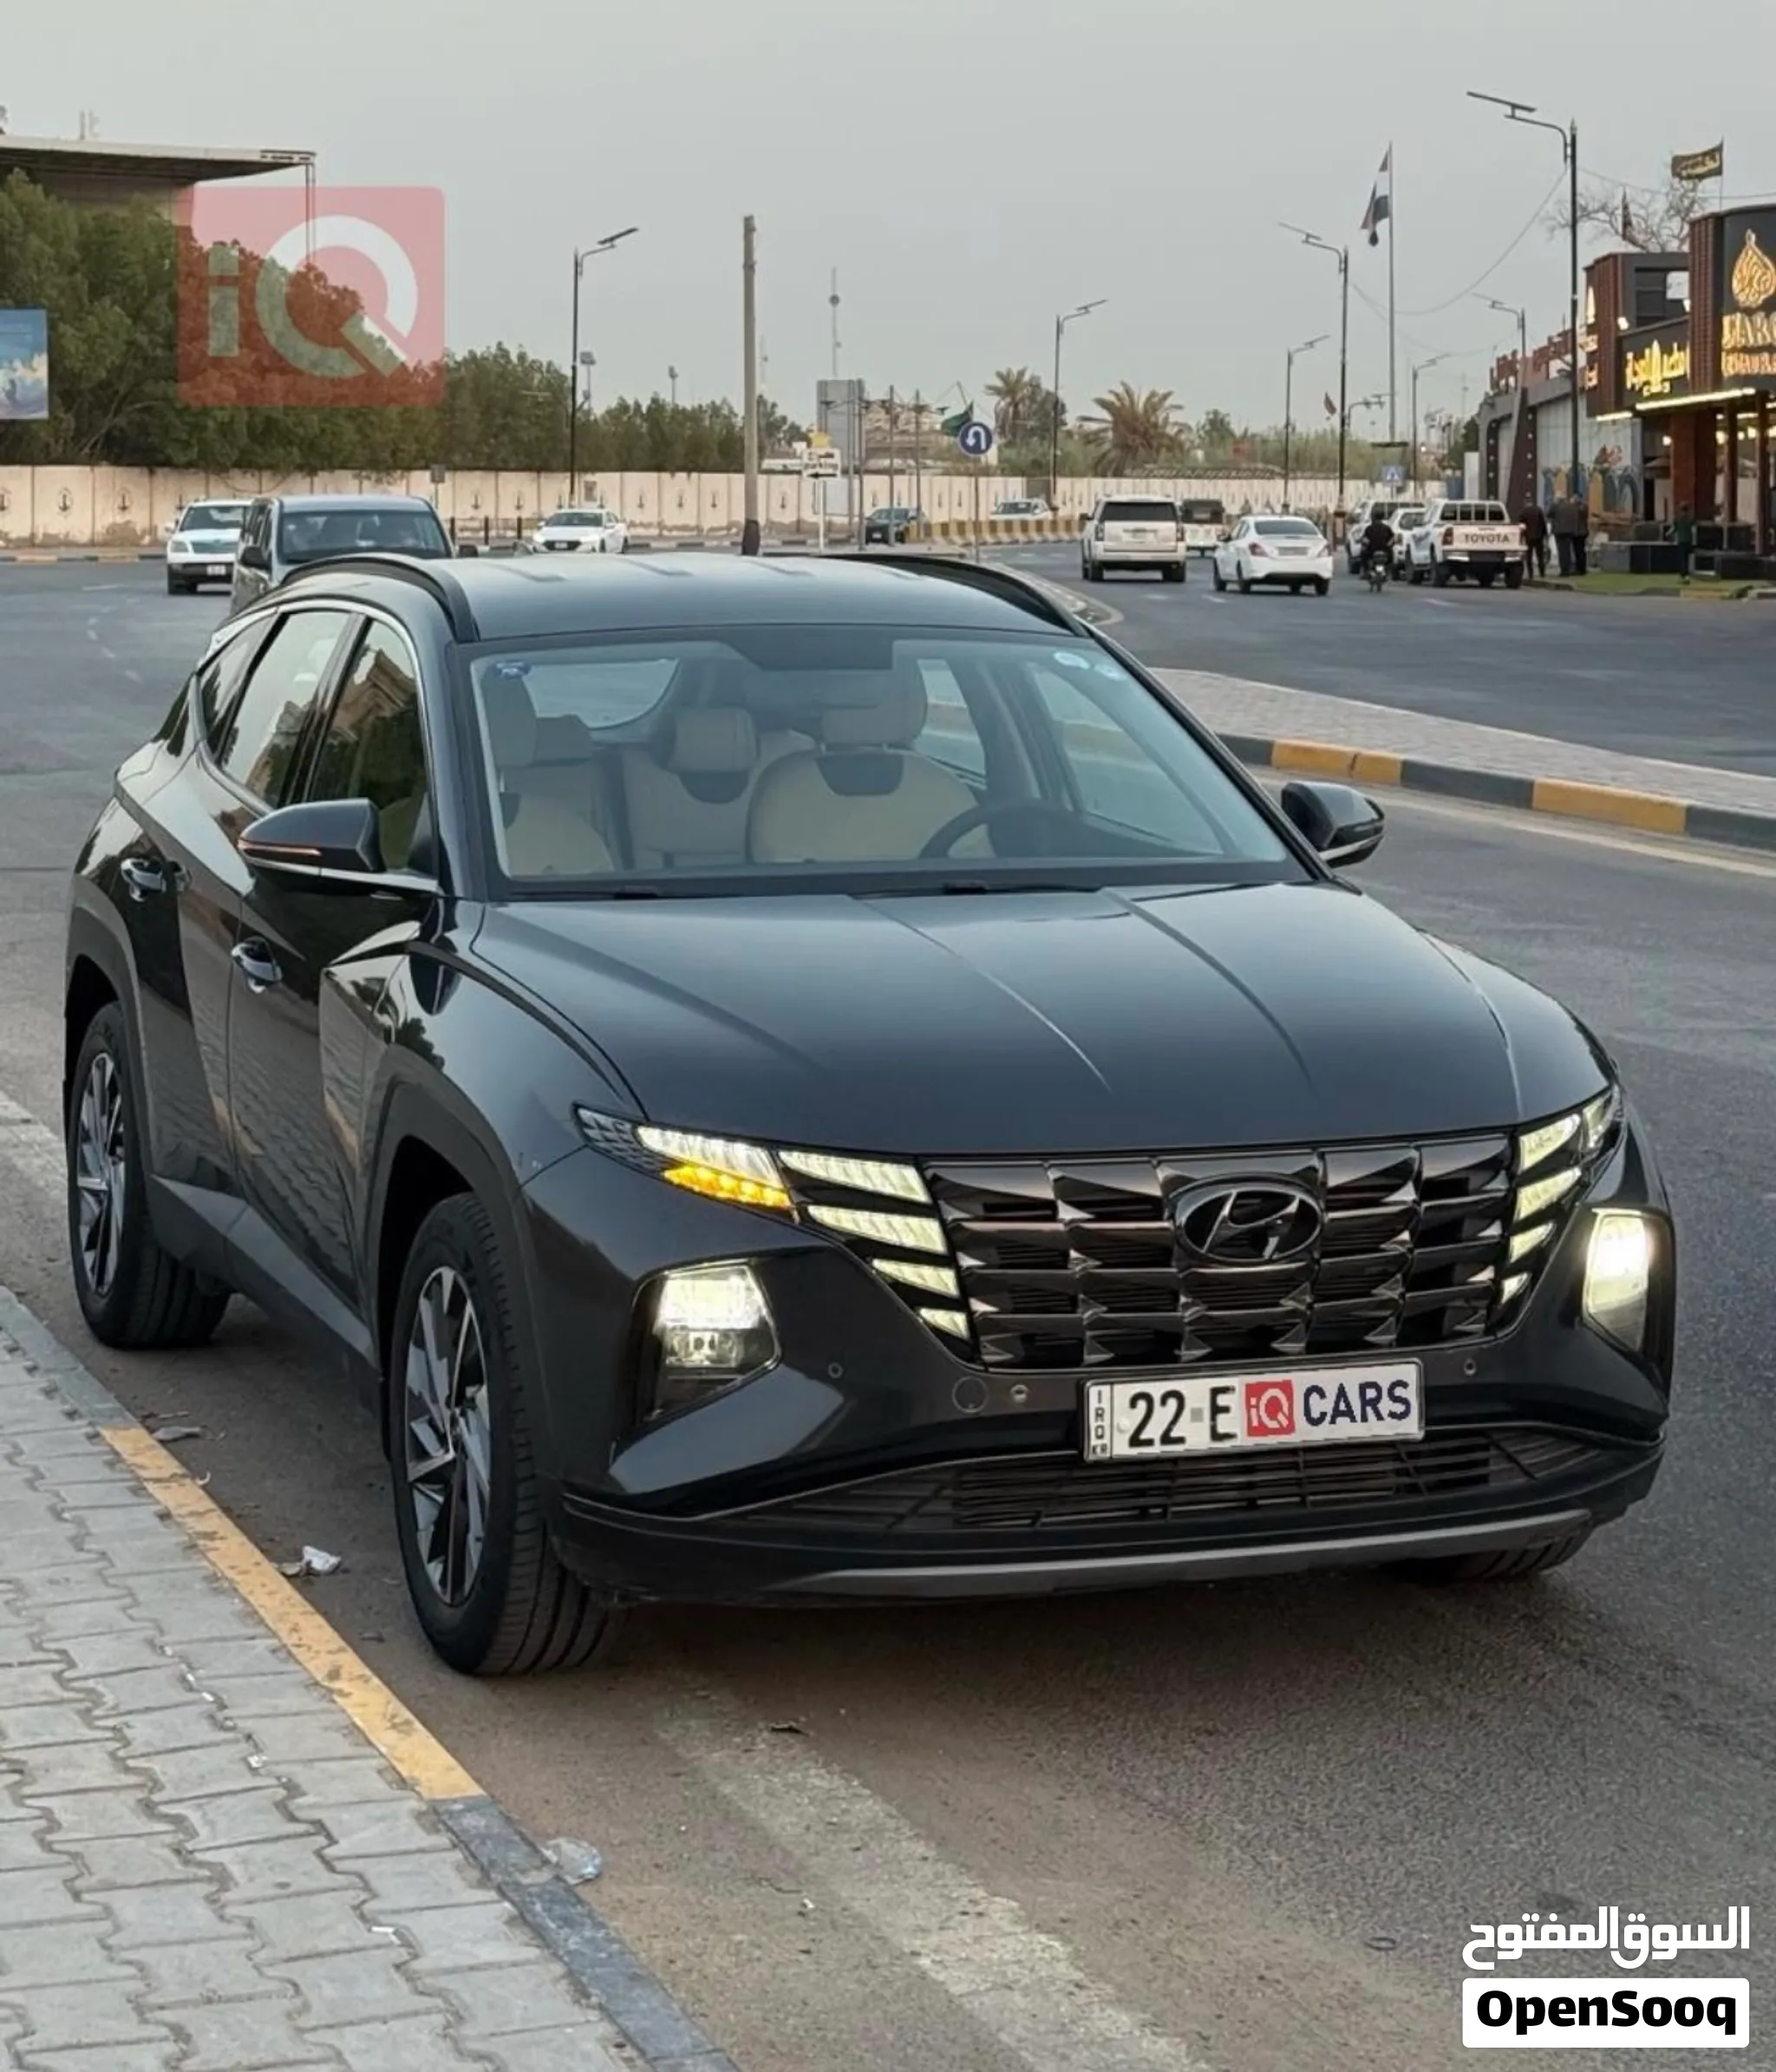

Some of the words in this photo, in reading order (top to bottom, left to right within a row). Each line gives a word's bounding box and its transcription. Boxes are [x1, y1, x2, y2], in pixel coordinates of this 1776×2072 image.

[1465, 533, 1510, 544] TOYOTA
[1128, 1389, 1186, 1448] 22
[1209, 1385, 1237, 1441] E
